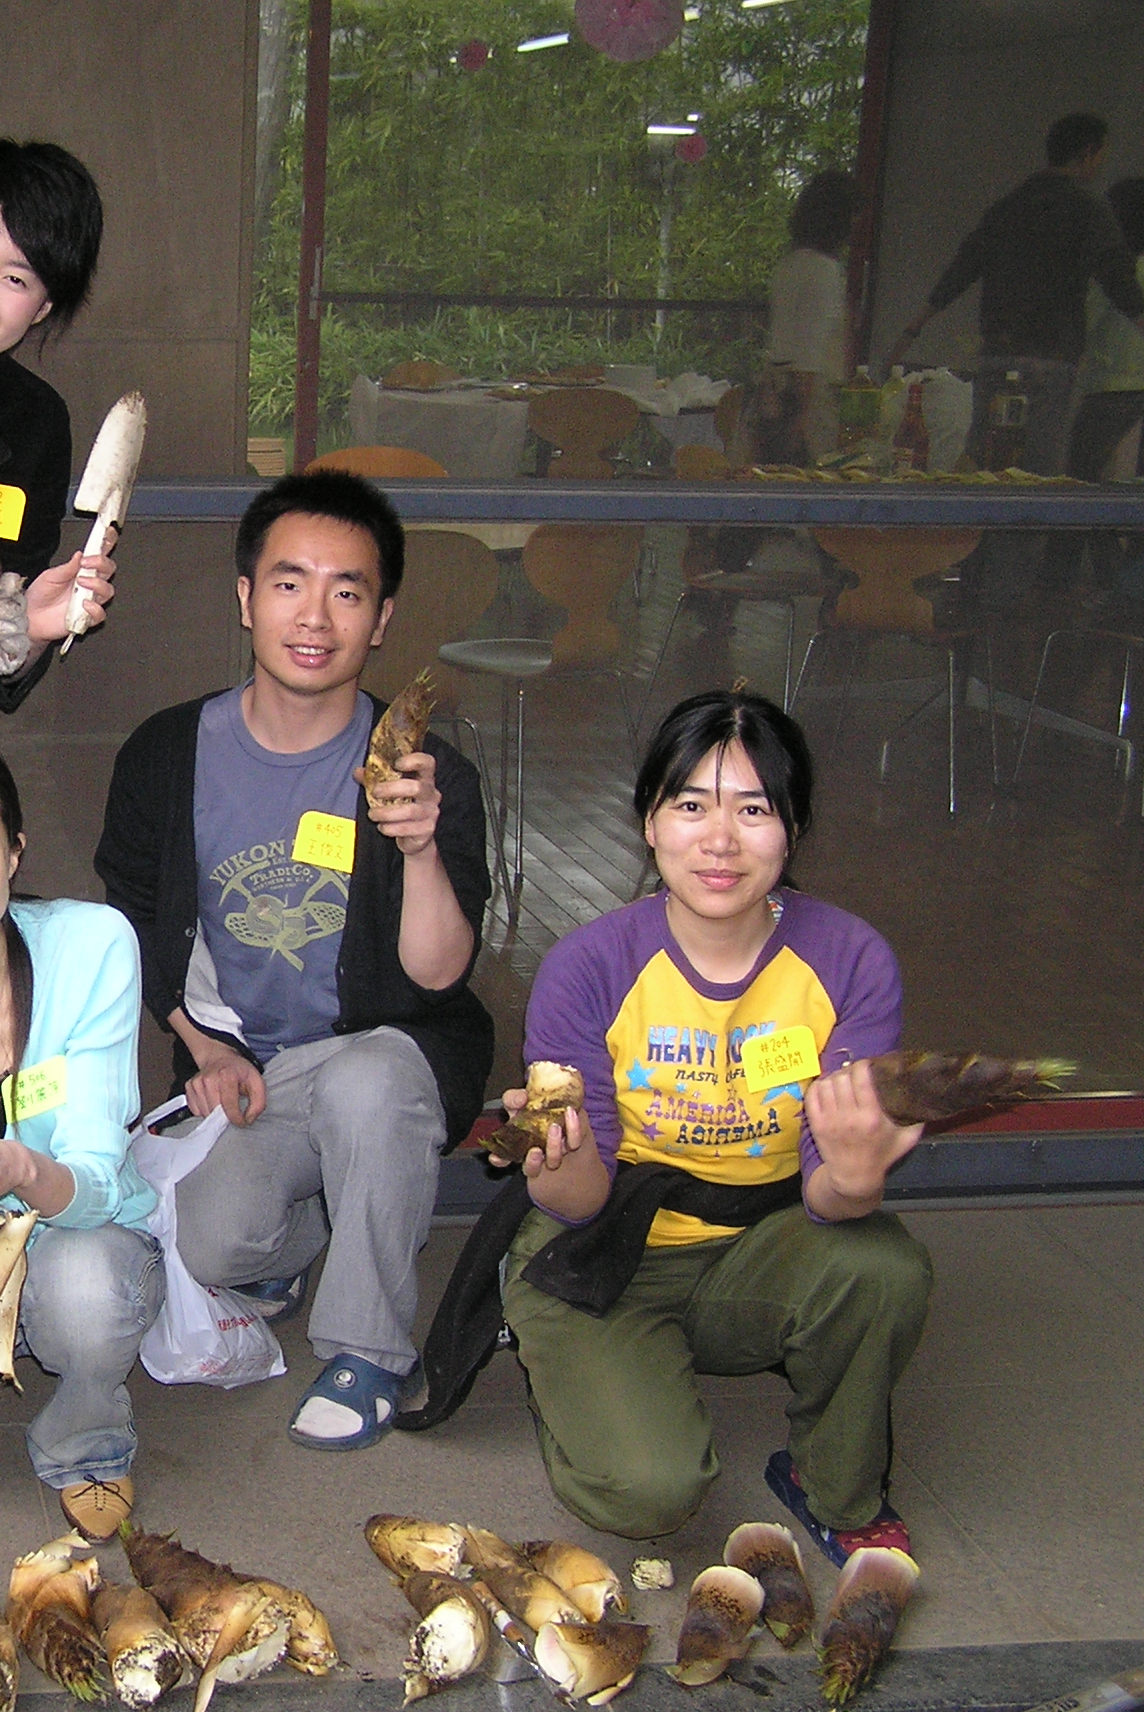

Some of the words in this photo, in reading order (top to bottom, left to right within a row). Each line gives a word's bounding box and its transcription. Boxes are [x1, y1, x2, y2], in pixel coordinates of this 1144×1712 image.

[209, 839, 285, 886] YUKON
[646, 1025, 718, 1068] HEAVY
[759, 1035, 790, 1053] #204
[645, 1088, 750, 1125] AMERICA
